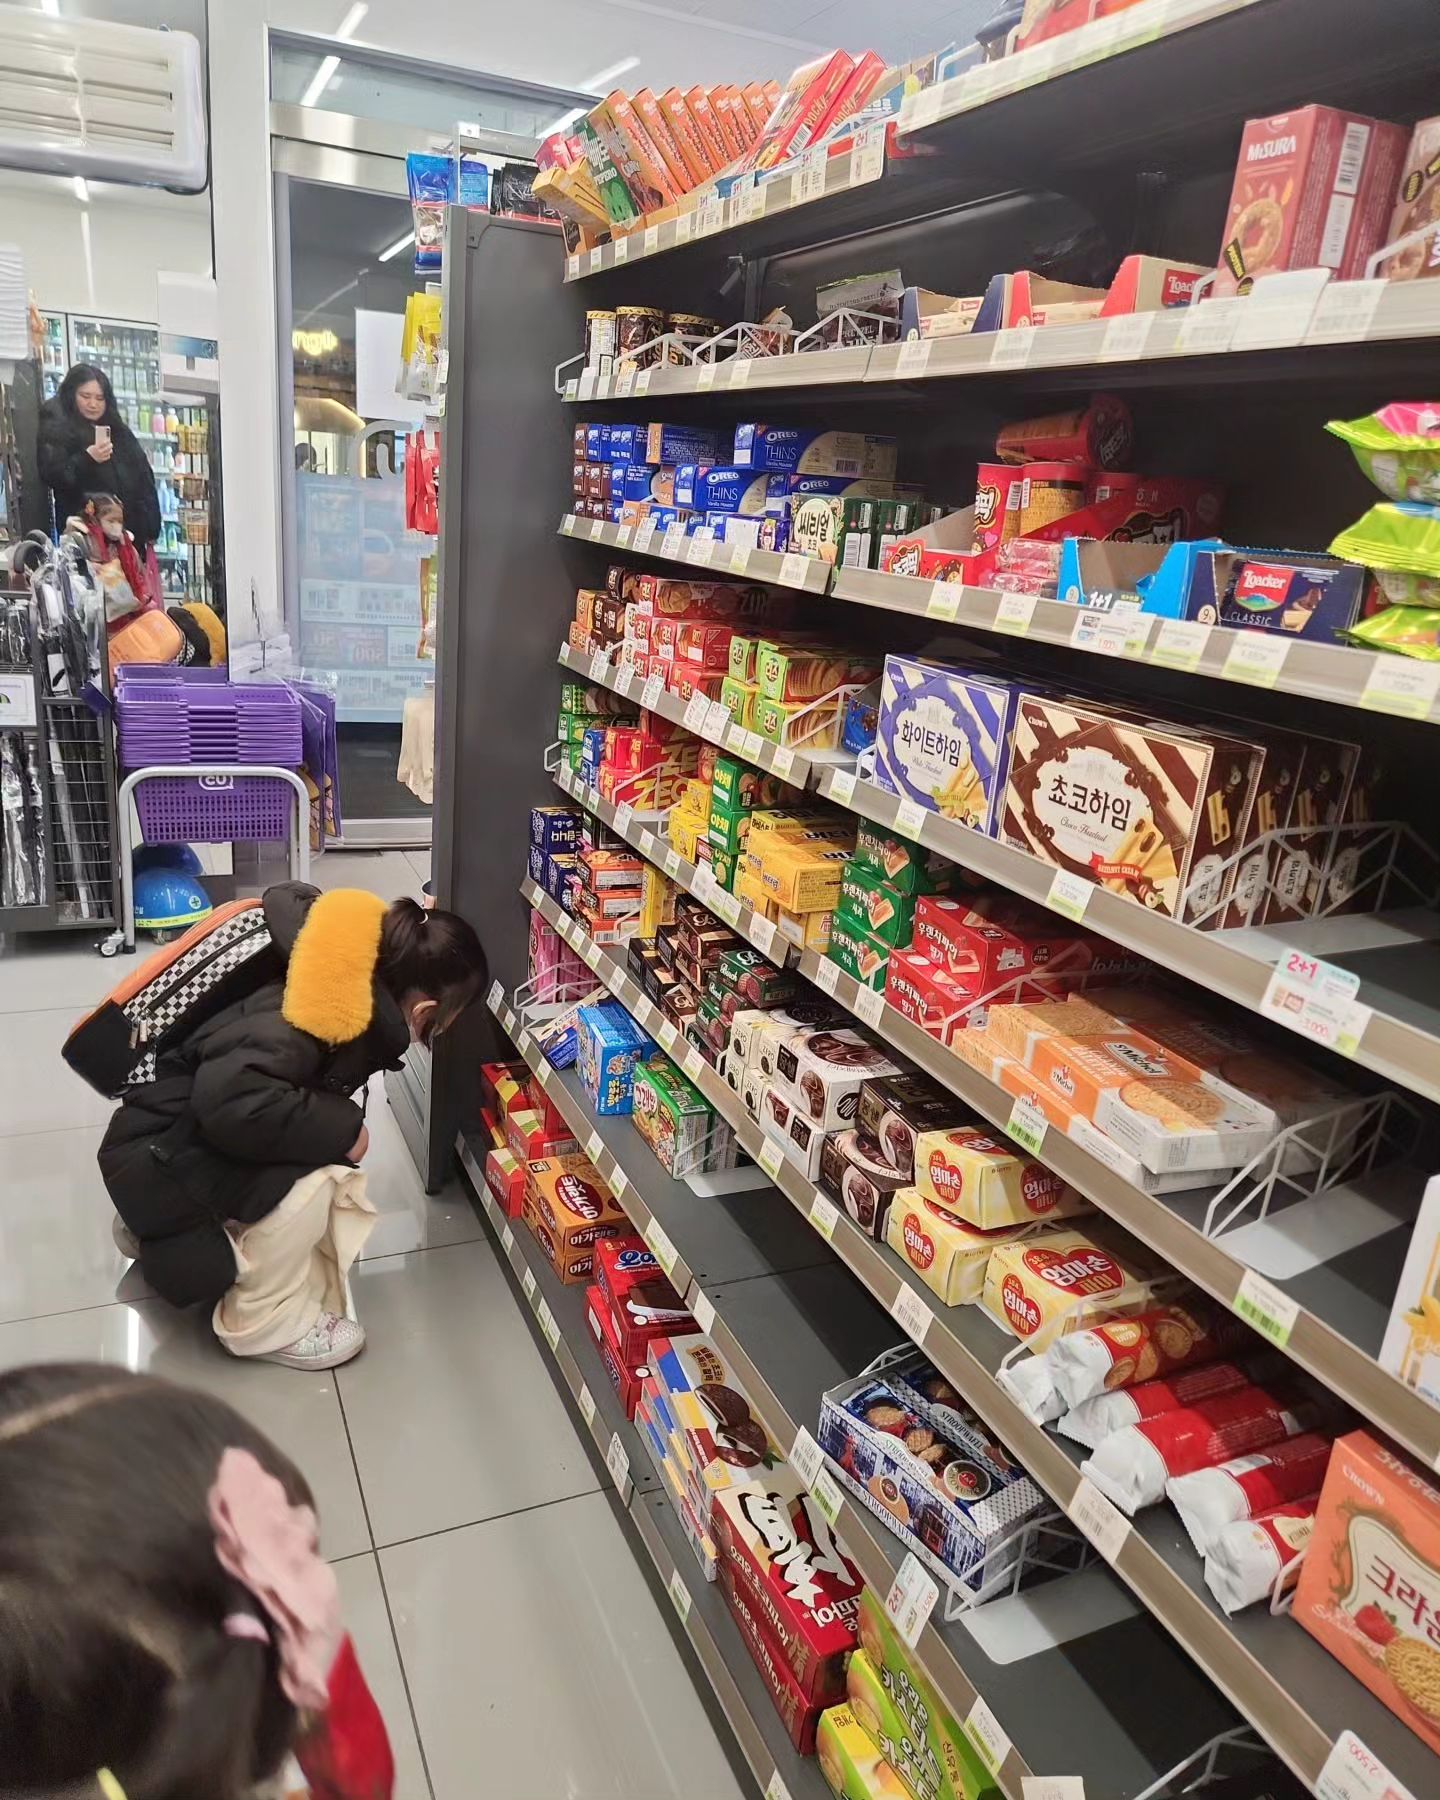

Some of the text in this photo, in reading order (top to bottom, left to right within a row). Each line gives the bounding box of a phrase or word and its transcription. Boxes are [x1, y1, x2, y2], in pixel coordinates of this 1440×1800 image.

[804, 97, 829, 129] POCKY
[594, 167, 619, 185] PEPERO
[766, 431, 798, 442] OREO
[765, 444, 797, 460] THINS
[707, 471, 739, 484] OREO
[799, 480, 829, 491] OREO
[706, 486, 738, 500] THINS
[798, 511, 829, 543] 씨리얼
[1243, 571, 1286, 591] Loacker
[1089, 591, 1113, 611] 1+1
[1230, 611, 1273, 626] CLASSIC
[901, 719, 962, 768] 화이트하임
[206, 775, 227, 786] CU
[1047, 774, 1131, 832] 초코하임
[858, 833, 891, 863] 후렌치파이
[868, 852, 881, 868] 사과
[762, 873, 781, 891] 버터링
[842, 882, 876, 914] 후렌치파이
[851, 903, 865, 918] 사과
[832, 931, 864, 964] 후렌치파이
[918, 921, 958, 960] 후렌치파이
[841, 952, 854, 968] 사과
[929, 945, 945, 965] 딸기
[1287, 953, 1318, 979] 2+1
[890, 975, 928, 1013] 후렌치파이
[901, 998, 915, 1018] 딸기
[734, 1027, 748, 1043] ZERO
[762, 1045, 775, 1062] ZERO
[746, 1081, 758, 1097] ZERO
[930, 1164, 963, 1189] 엄마손
[939, 1185, 957, 1200] 파이
[1023, 1177, 1062, 1201] 엄마손
[903, 1227, 933, 1260] 엄마손
[569, 1260, 593, 1274] 마가
[910, 1249, 928, 1268] 파이
[1040, 1255, 1113, 1288] 엄마손
[1080, 1276, 1121, 1296] 파이
[1003, 1288, 1041, 1327] 엄마손
[1010, 1314, 1030, 1335] 파이
[940, 1410, 983, 1449] STROOPWAFEL
[1342, 1463, 1385, 1506] CROWN
[863, 1491, 914, 1545] STROOPWAFEL
[889, 1587, 904, 1614] 2+1
[899, 1669, 928, 1729] 오리온
[881, 1663, 943, 1789] 카스타드
